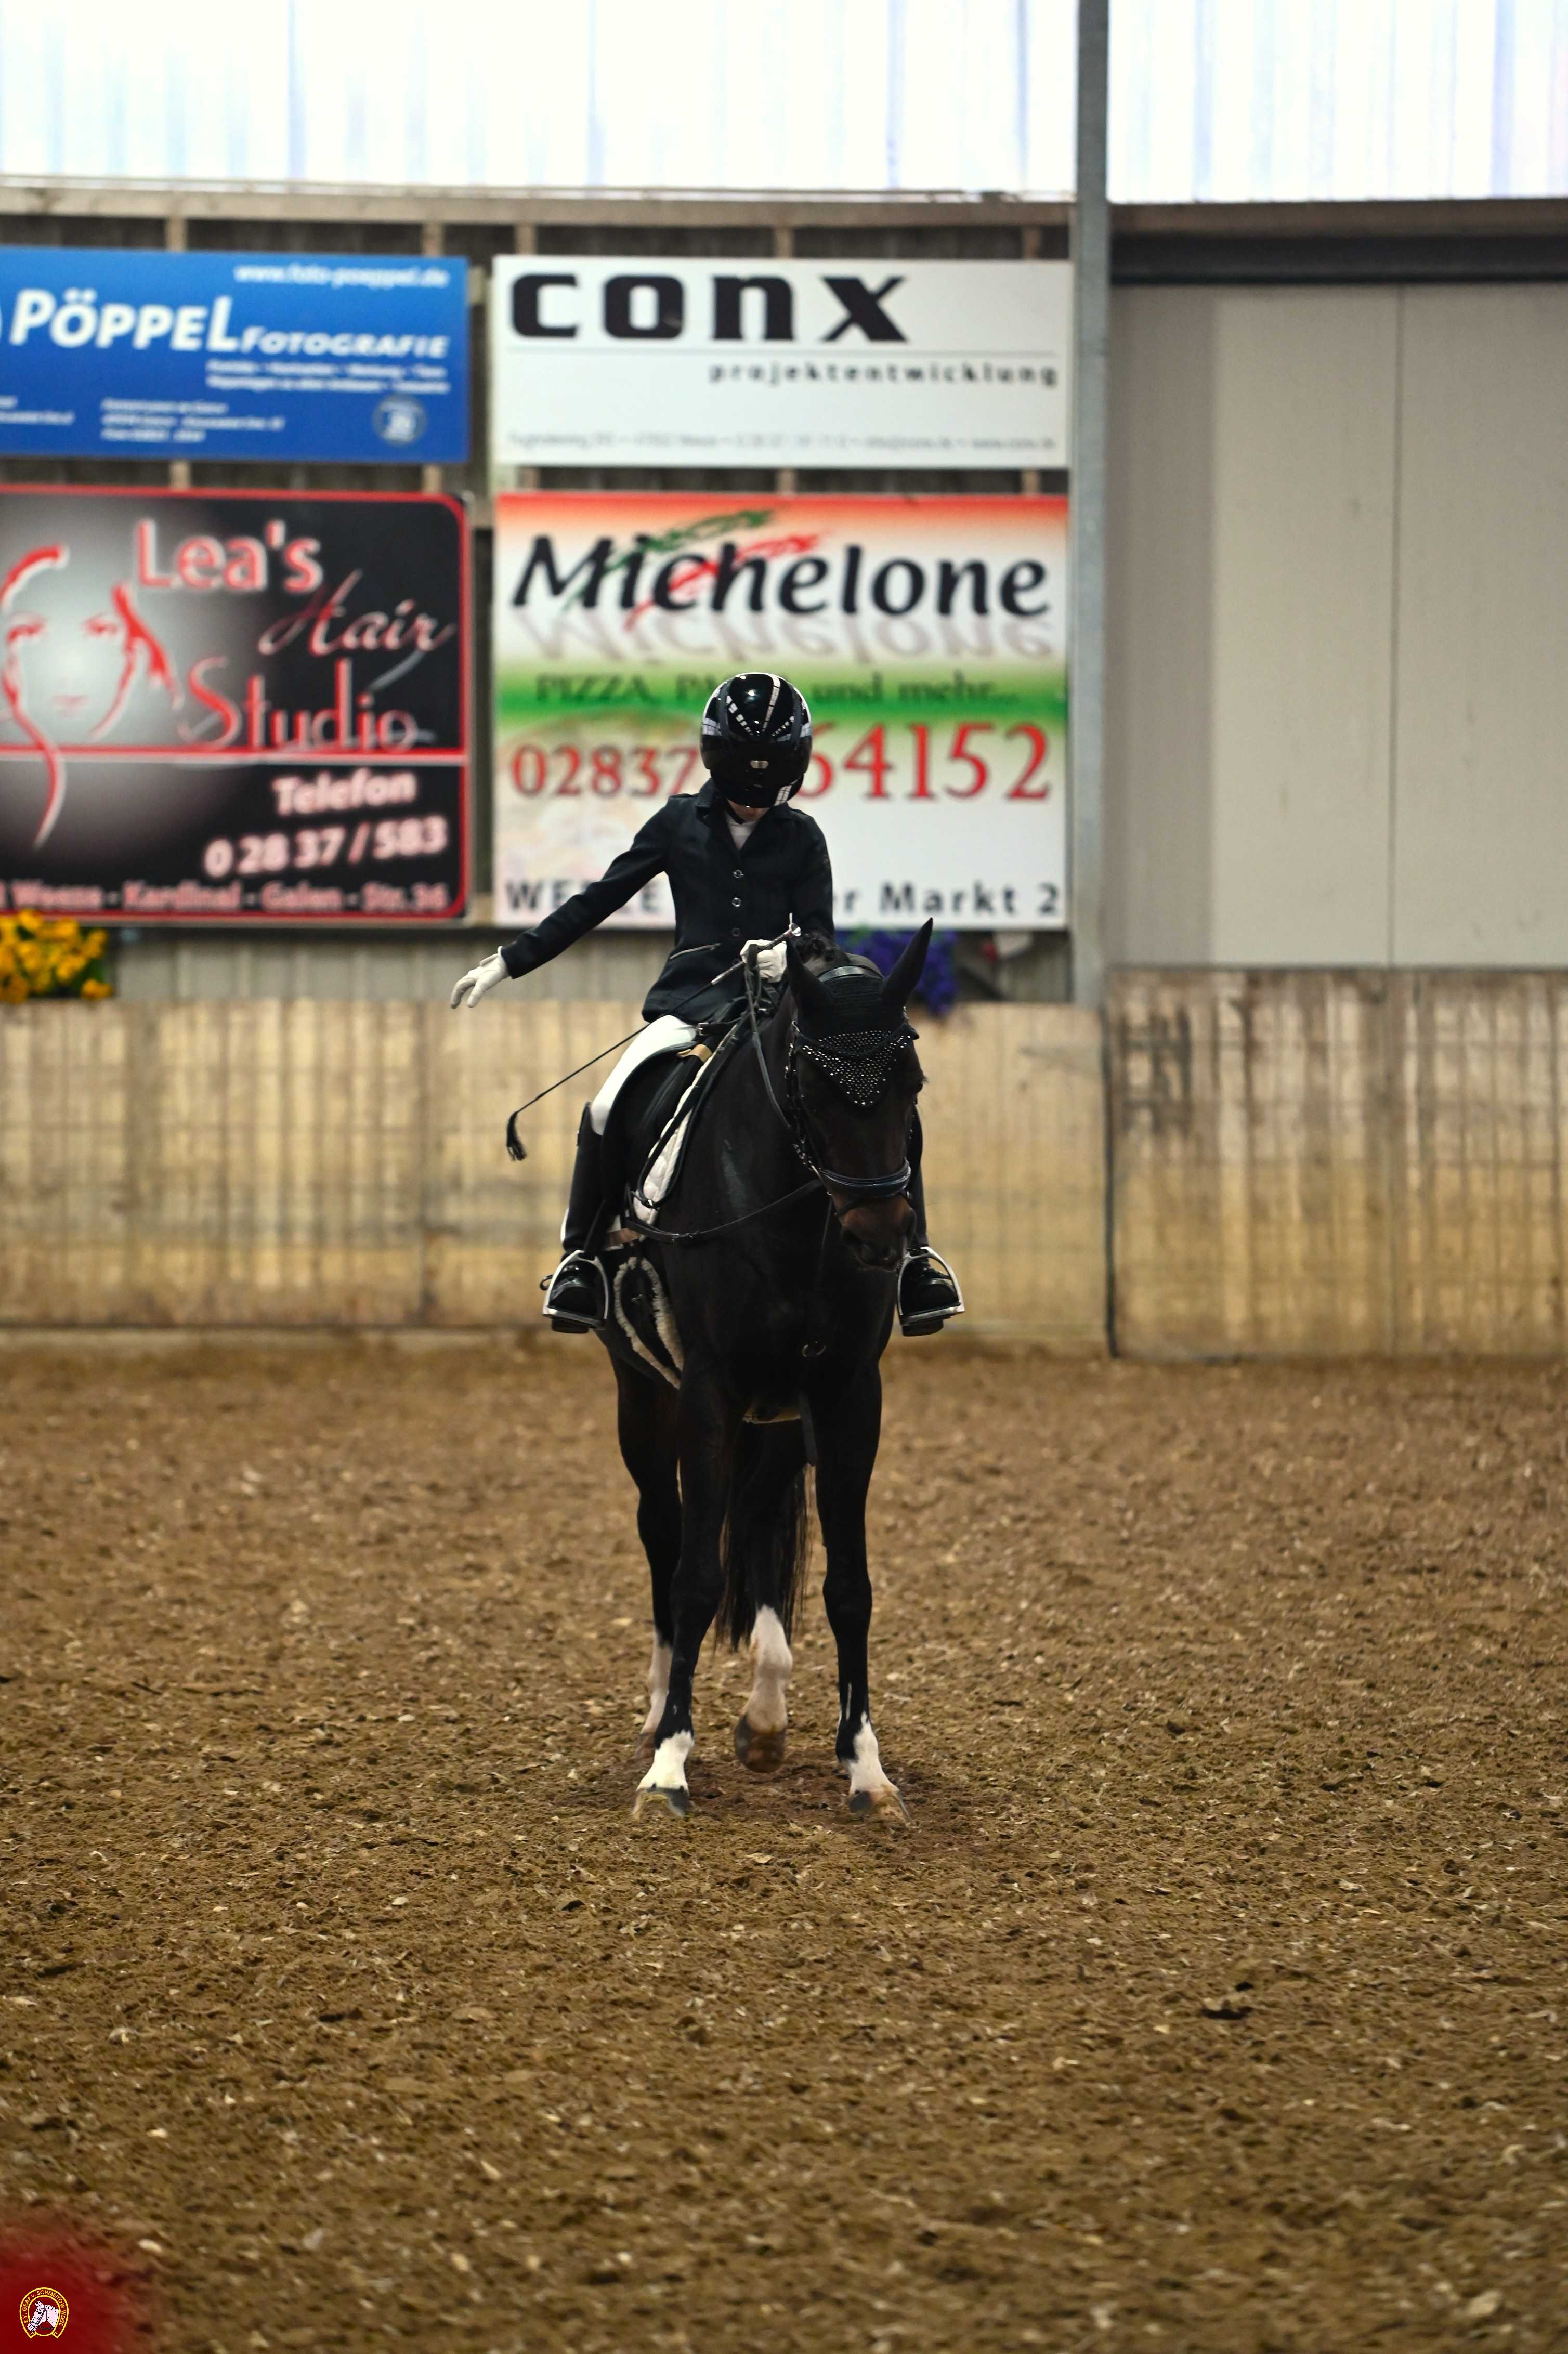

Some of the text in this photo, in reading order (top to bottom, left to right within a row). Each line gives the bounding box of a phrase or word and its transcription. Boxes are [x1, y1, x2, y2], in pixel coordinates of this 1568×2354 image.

[9, 287, 449, 358] PÖPPEL FOTOGRAFIE
[511, 273, 909, 343] conx
[709, 360, 1059, 388] projektentwicklung
[136, 517, 324, 594] Lea's
[512, 533, 1050, 617] Michelone
[258, 569, 455, 657] Hair
[180, 656, 429, 752] Studio
[811, 670, 882, 702] und
[272, 768, 417, 816] Telefon
[512, 722, 1050, 801] 02837 64152
[204, 838, 233, 878] 0
[504, 879, 664, 913] WEE
[881, 879, 1017, 914] Markt
[1037, 882, 1059, 914] 2
